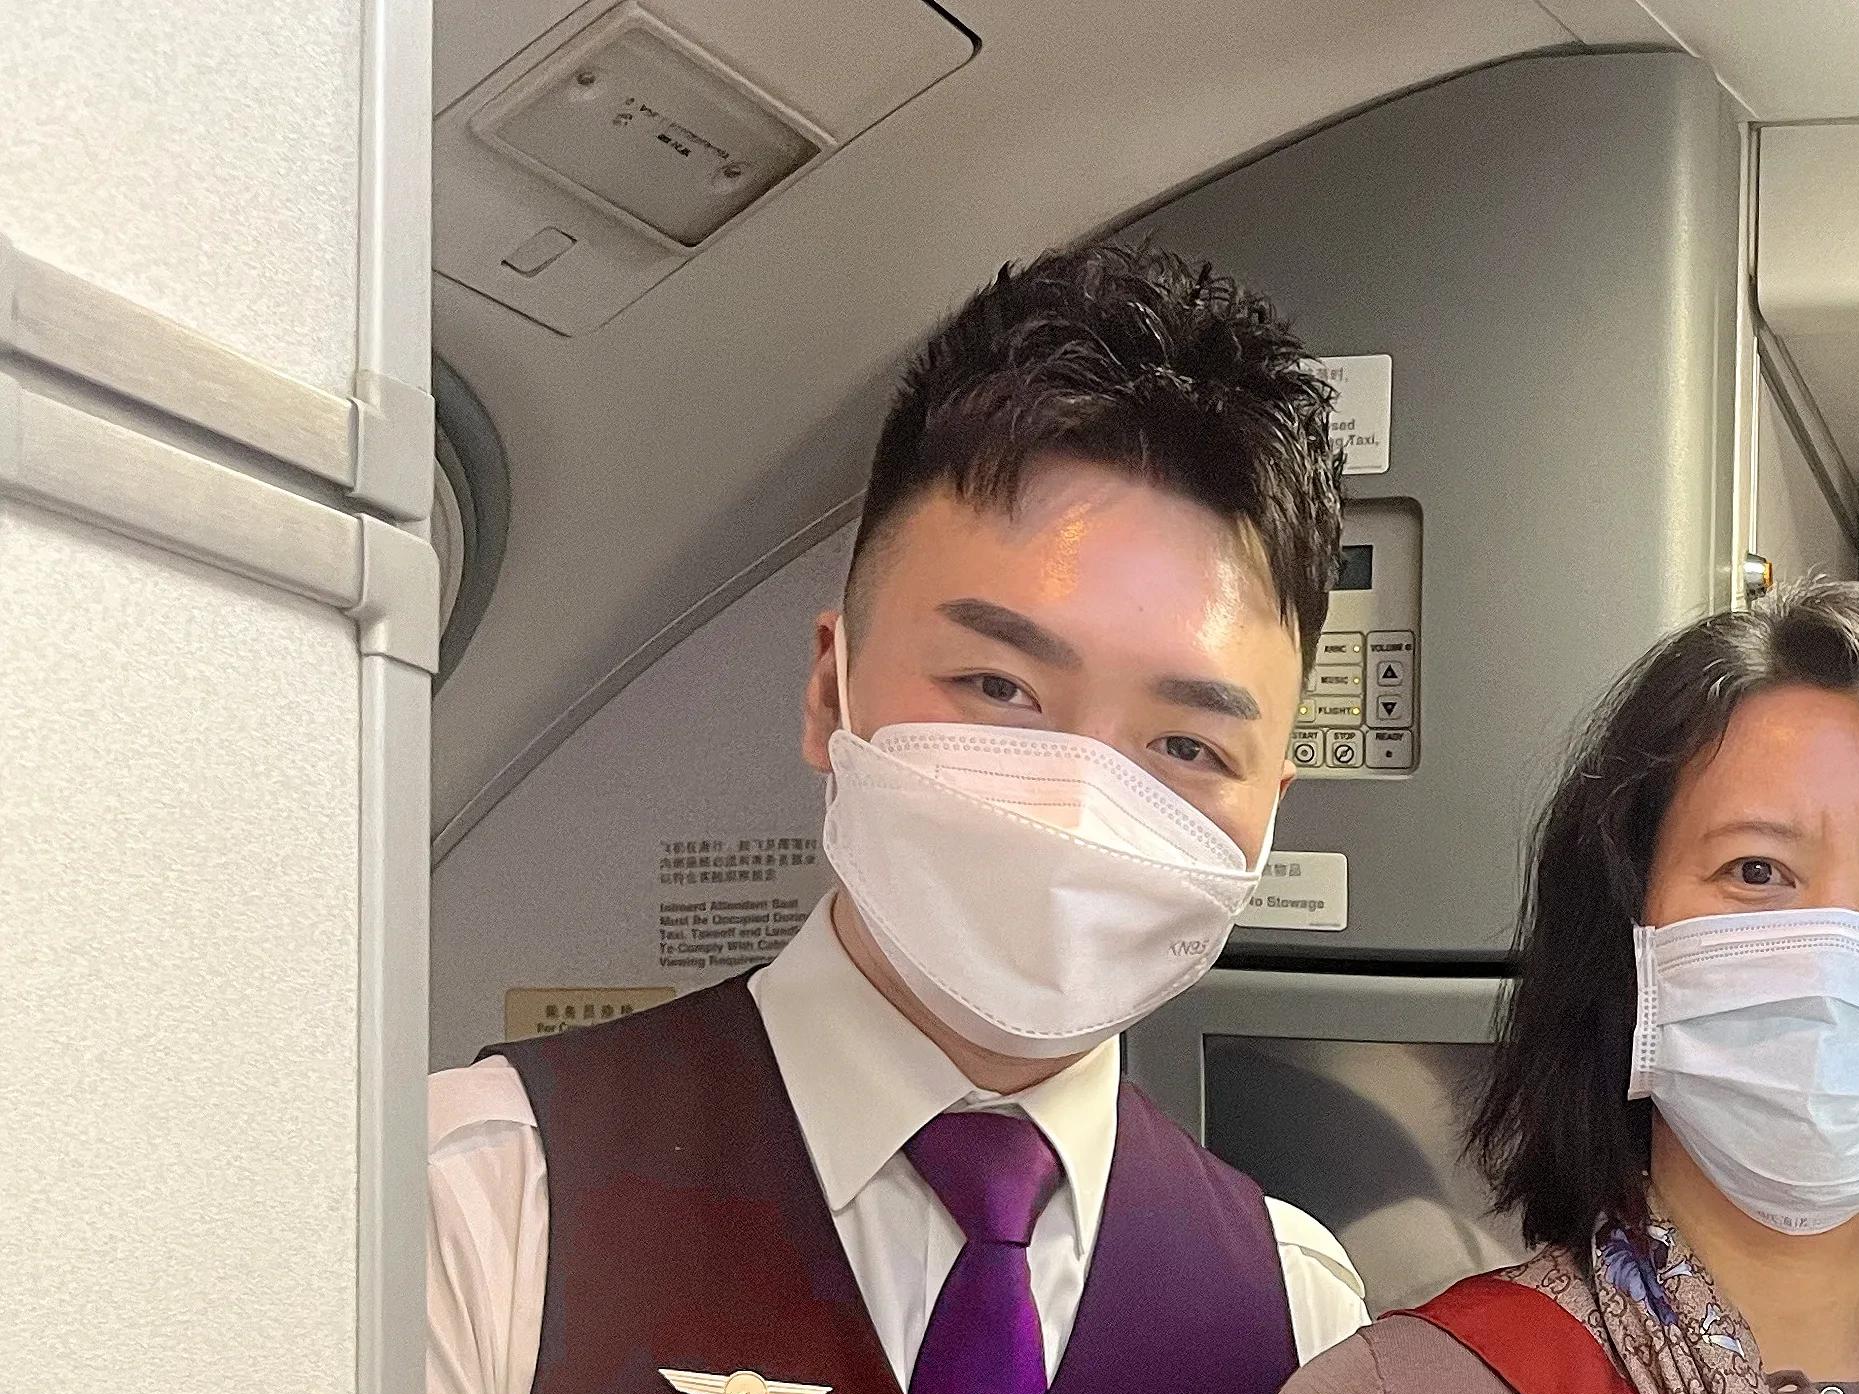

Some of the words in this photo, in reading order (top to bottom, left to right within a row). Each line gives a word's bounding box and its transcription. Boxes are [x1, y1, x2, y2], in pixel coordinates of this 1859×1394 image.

[1318, 706, 1352, 716] FLIGHT
[1333, 732, 1356, 741] STOP
[1266, 896, 1326, 912] Stowage
